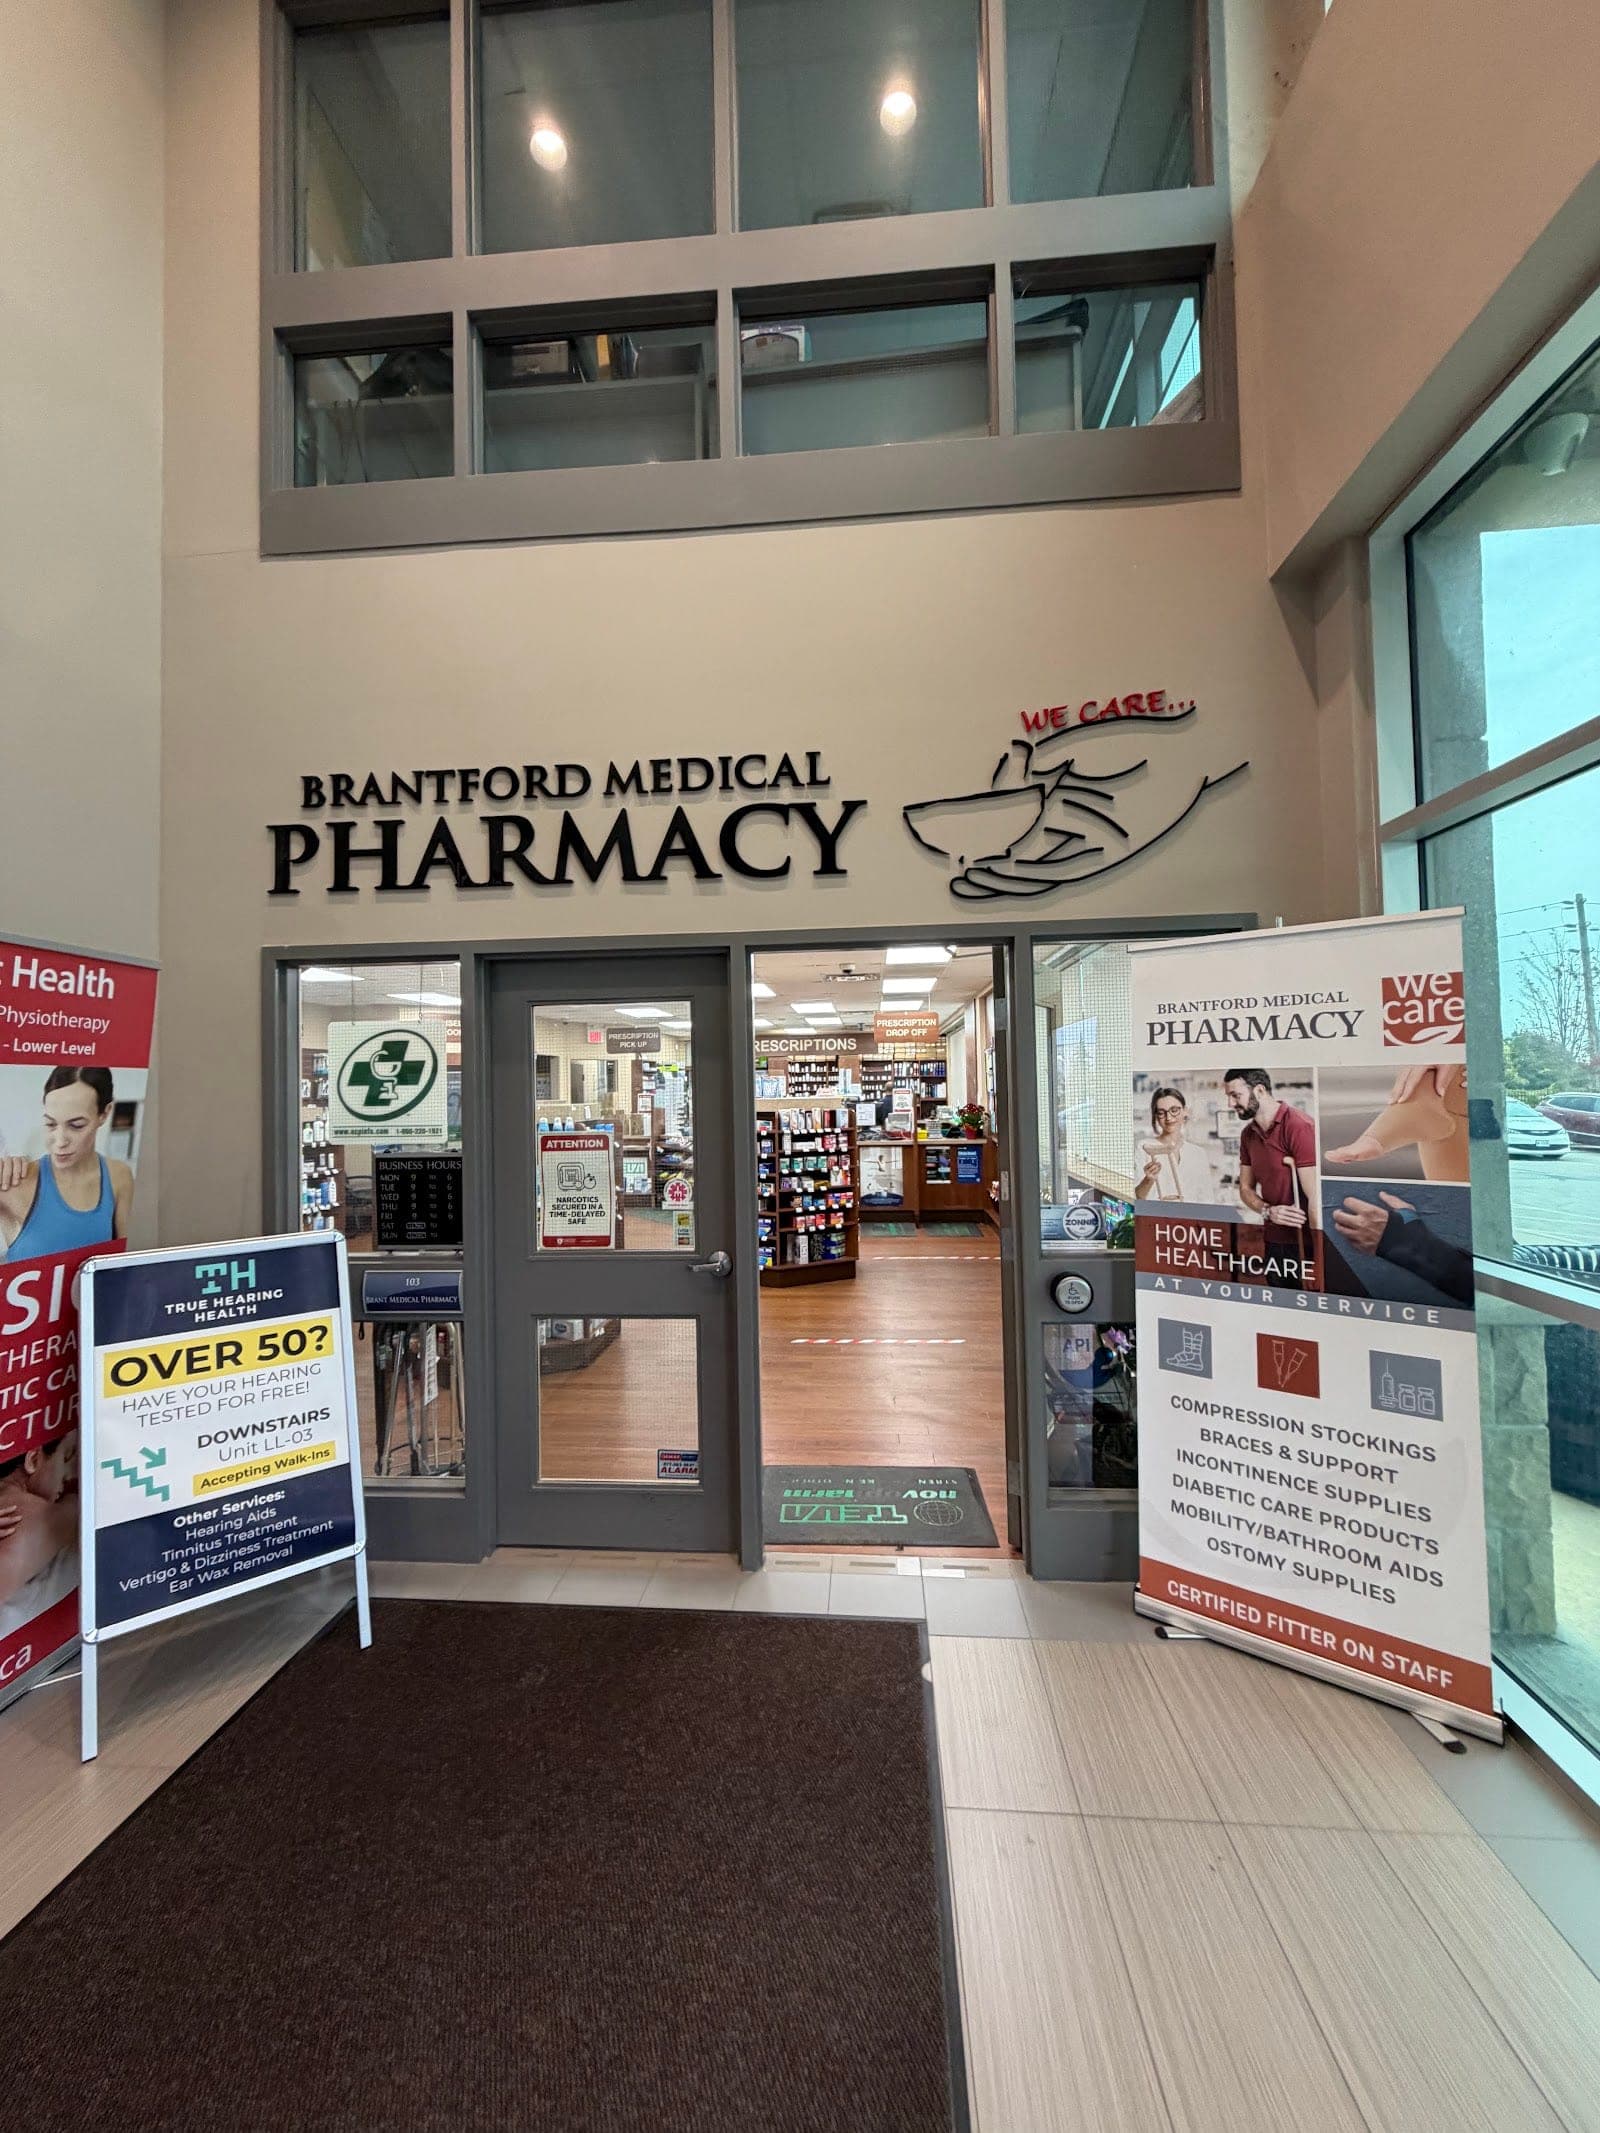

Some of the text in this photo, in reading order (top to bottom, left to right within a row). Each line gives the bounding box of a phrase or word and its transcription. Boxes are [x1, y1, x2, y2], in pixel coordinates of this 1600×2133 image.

[1021, 705, 1069, 733] WE
[300, 751, 831, 809] BRANTFORD MEDICAL
[267, 800, 868, 894] PHARMACY
[12, 955, 115, 999] Health
[1392, 972, 1452, 998] we
[1157, 990, 1349, 1015] BRANTFORD MEDICAL
[1383, 996, 1465, 1024] care
[608, 1031, 659, 1040] PRESCRIPTION
[877, 1018, 937, 1028] PRESCRIPTION
[886, 1028, 928, 1037] DROP OFF
[1146, 1009, 1365, 1046] PHARMACY
[13, 1038, 58, 1054] Lower
[61, 1041, 96, 1056] Level
[546, 1139, 604, 1149] ATTENTION
[379, 1160, 462, 1170] BUSINESS HOURS
[380, 1183, 395, 1191] TUE
[380, 1193, 400, 1201] WED
[380, 1203, 398, 1211] THU
[549, 1210, 606, 1218] TIME-DELAYED
[381, 1222, 395, 1230] SAT
[381, 1232, 398, 1240] SUN
[1155, 1223, 1223, 1248] HOME
[195, 1258, 256, 1295] TH
[1155, 1246, 1316, 1281] HEALTHCARE
[365, 1295, 458, 1304] BRANT MEDICAL PHARMACY
[405, 1277, 421, 1287] 103
[164, 1288, 283, 1315] TRUE HEARING
[194, 1304, 257, 1323] HEALTH
[1155, 1276, 1440, 1324] AT YOUR SERVICE
[110, 1324, 328, 1387] OVER 50?
[122, 1363, 321, 1413] HAVE YOUR HEARING
[137, 1381, 310, 1428] TESTED FOR FREE!
[197, 1407, 331, 1449] DOWNSTAIRS
[219, 1428, 313, 1462] Unit LL-03
[1170, 1394, 1437, 1463] COMPRESSION STOCKINGS
[200, 1448, 330, 1489] Accepting Walk-Ins
[660, 1466, 698, 1474] ALARM
[1200, 1428, 1399, 1484] BRACES & SUPPORT
[1176, 1448, 1432, 1523] INCONTINENCE SUPPLIES
[173, 1490, 285, 1529] Other Services:
[186, 1506, 277, 1541] Hearing Aids
[1172, 1473, 1440, 1556] DIABETIC CARE PRODUCTS
[119, 1519, 334, 1592] Vertigo & Dizziness Treatment
[162, 1515, 298, 1563] Tinnitus Treatment
[1170, 1499, 1444, 1588] MOBILITY/BATHROOM AIDS
[169, 1545, 294, 1594] Ear Wax Removal
[1207, 1536, 1397, 1605] OSTOMY SUPPLIES
[1167, 1580, 1453, 1689] CERTIFIED FITTER ON STAFF
